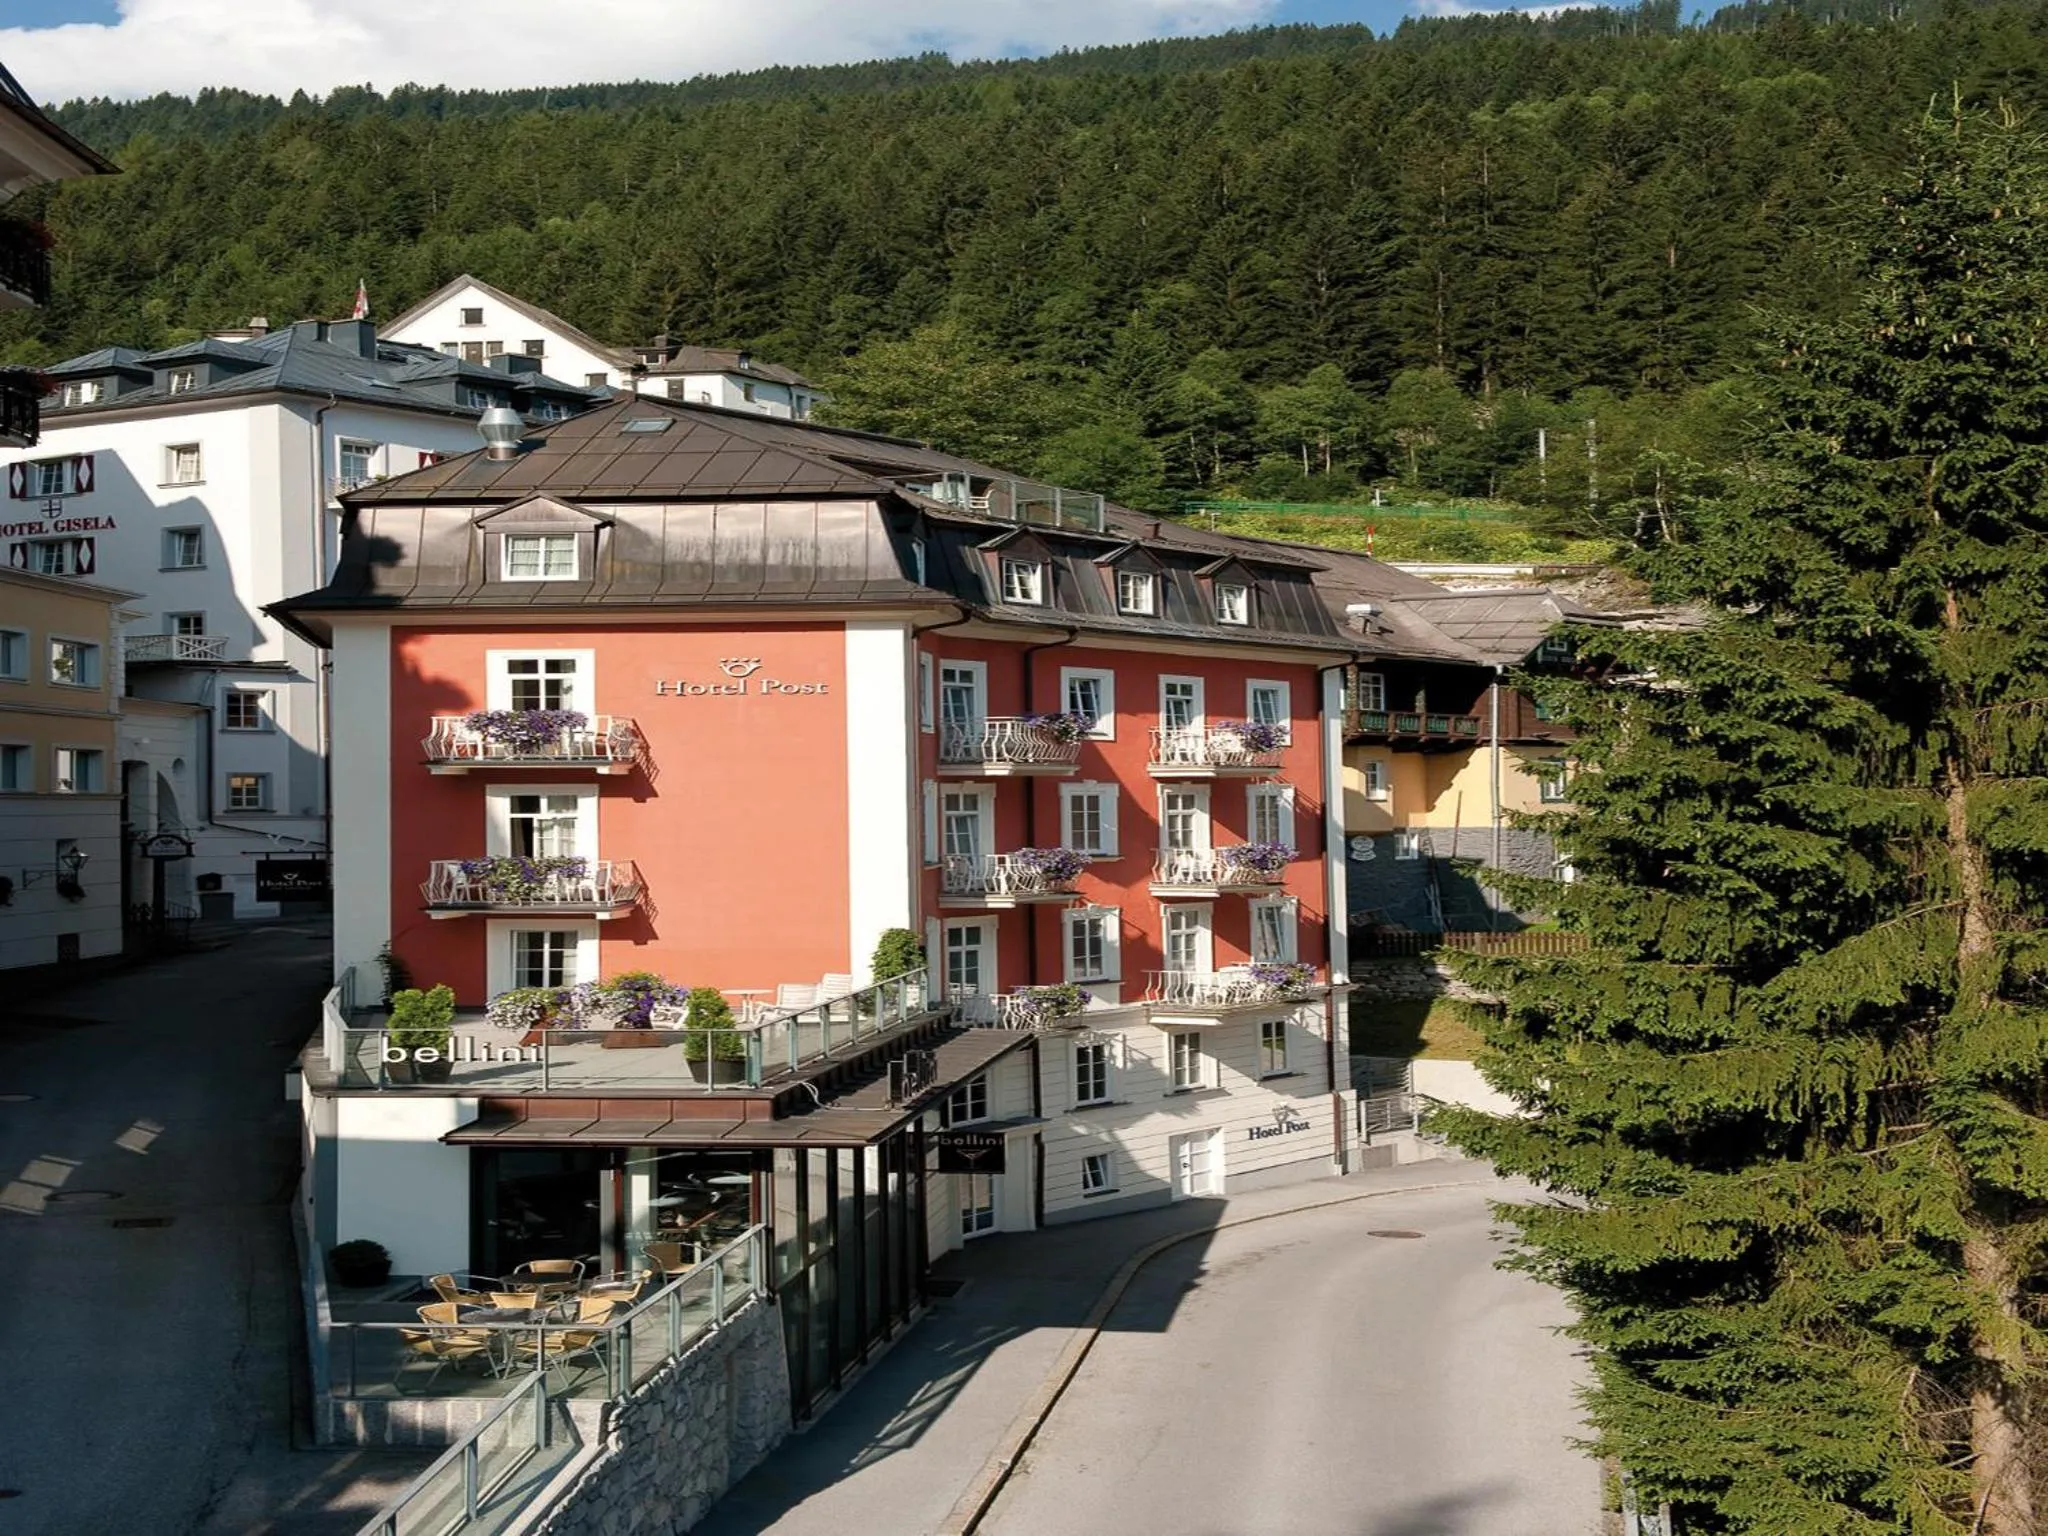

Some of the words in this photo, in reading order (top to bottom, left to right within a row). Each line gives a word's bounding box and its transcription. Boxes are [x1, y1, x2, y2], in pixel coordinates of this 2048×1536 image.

[0, 521, 48, 537] OTEL
[54, 515, 116, 533] GISELA
[656, 679, 748, 696] Hotel
[760, 679, 829, 695] Post
[382, 1036, 541, 1063] bellini
[940, 1134, 1003, 1145] bellini
[1248, 1122, 1283, 1140] Hotel
[1286, 1121, 1311, 1134] Post
